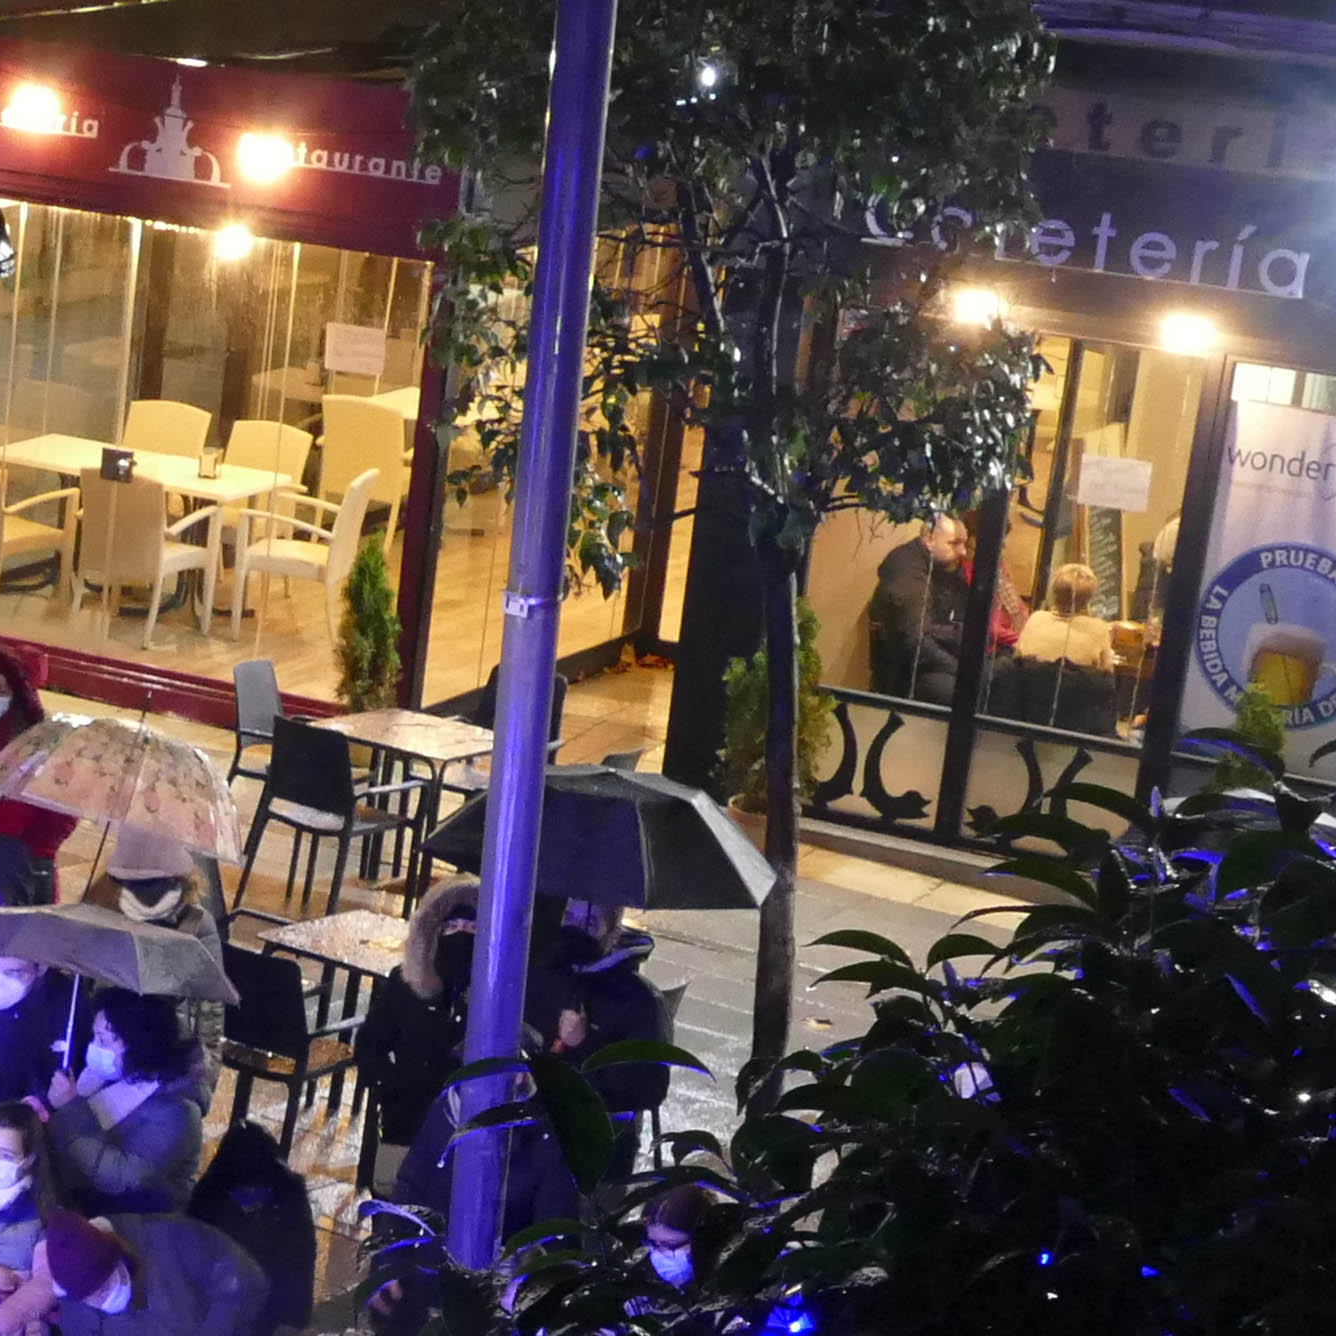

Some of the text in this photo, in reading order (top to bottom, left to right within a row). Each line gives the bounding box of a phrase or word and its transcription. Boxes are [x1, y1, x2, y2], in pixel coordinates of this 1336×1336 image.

[863, 193, 1311, 299] Caetería
[1198, 584, 1230, 688] LA BEBIDA
